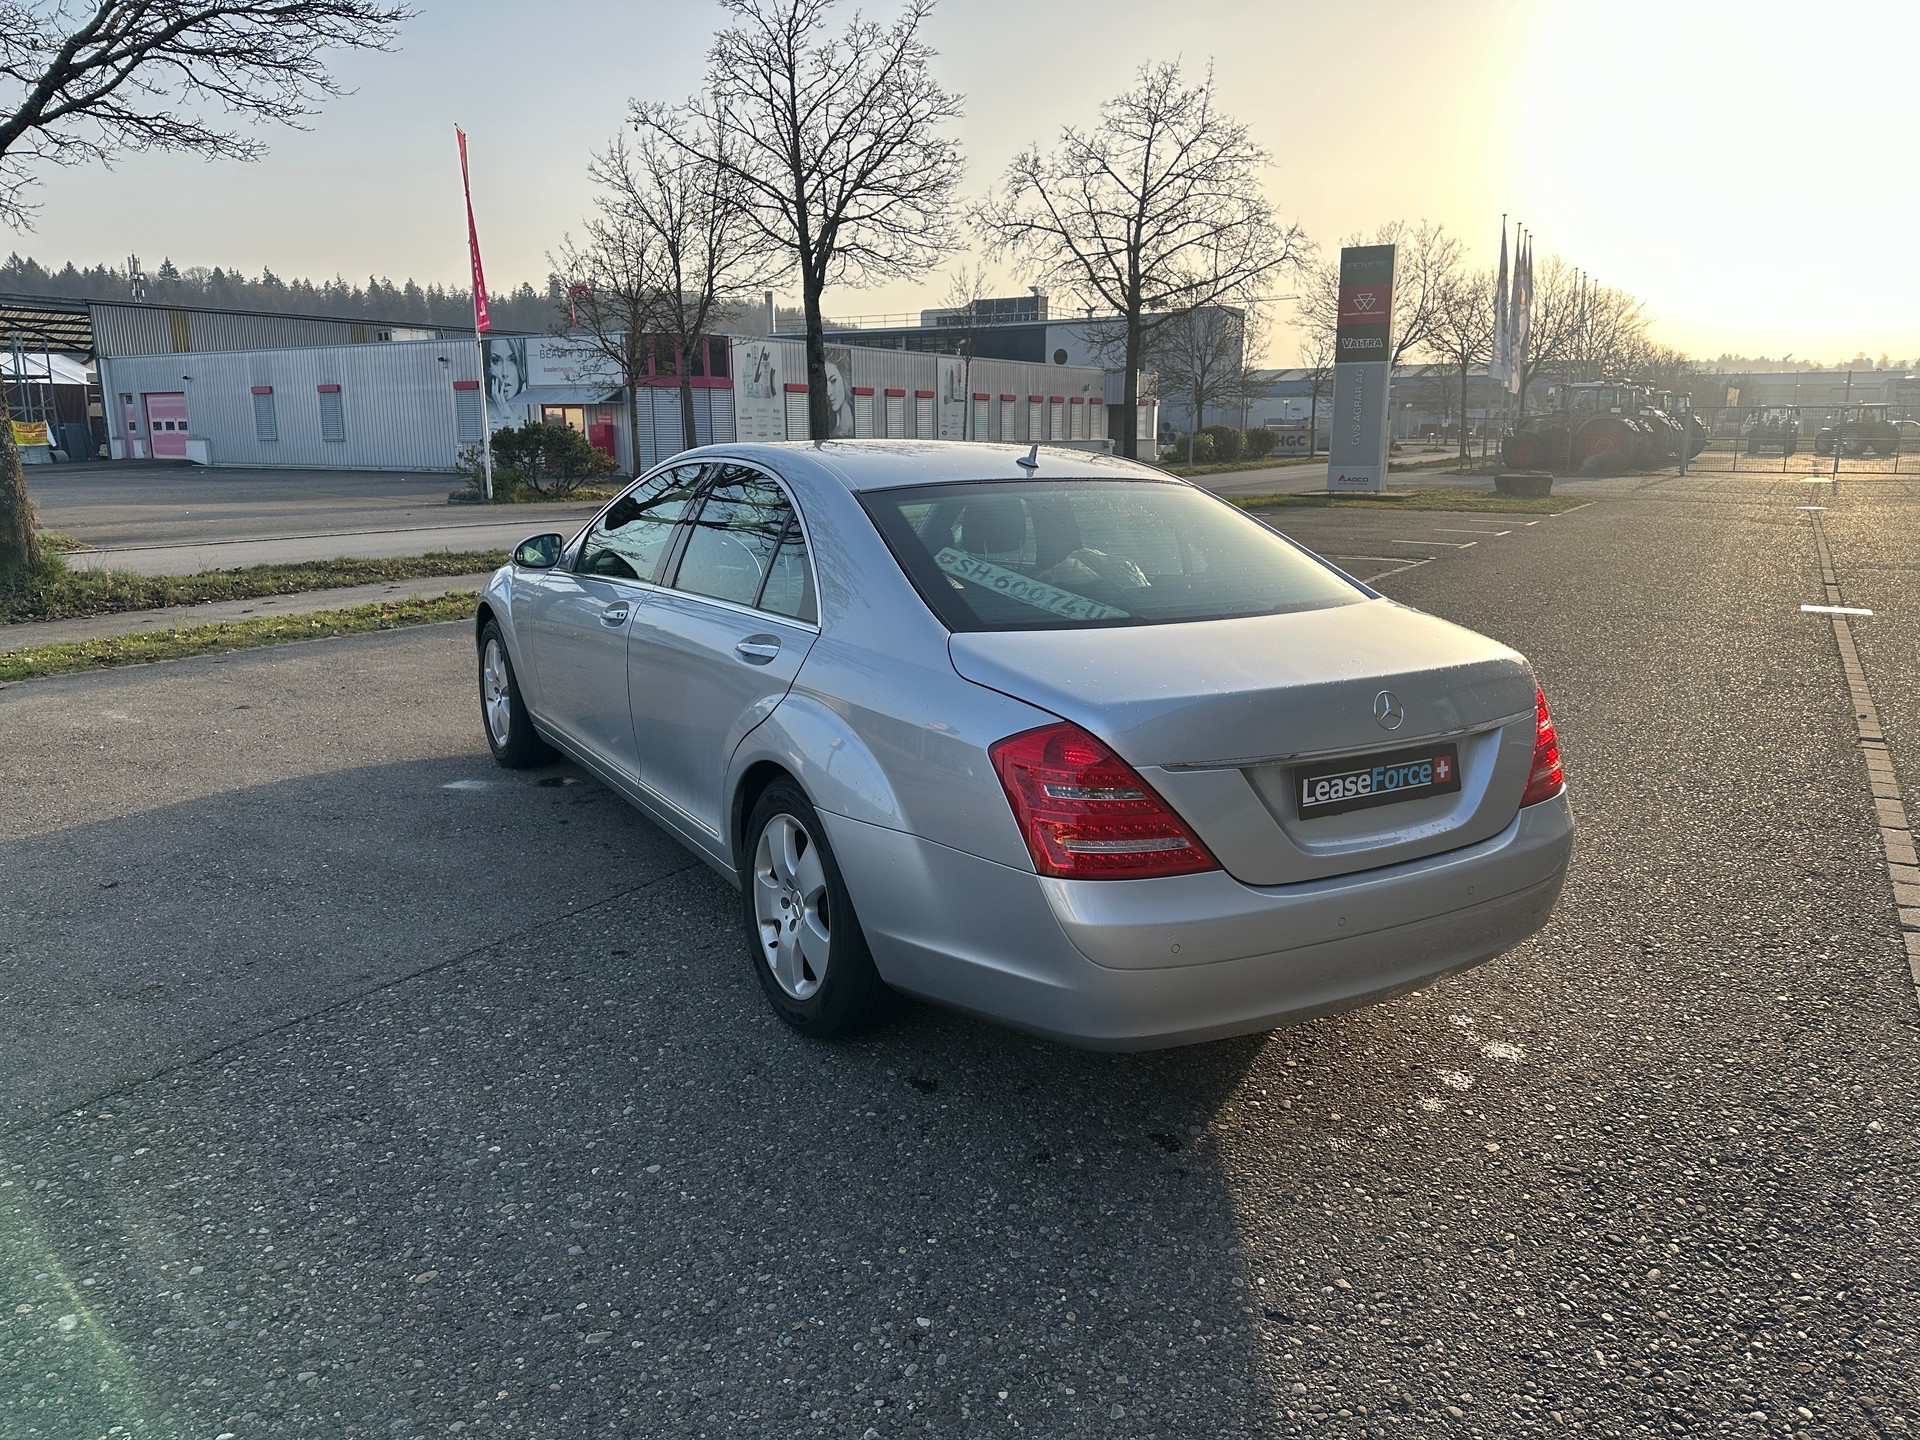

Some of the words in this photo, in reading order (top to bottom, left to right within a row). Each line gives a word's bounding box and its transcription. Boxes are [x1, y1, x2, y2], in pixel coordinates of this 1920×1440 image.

[1341, 337, 1383, 349] VALTRA
[1355, 368, 1365, 384] AG
[1353, 387, 1363, 422] AGRAR
[1351, 424, 1361, 446] GVS
[1302, 763, 1432, 804] LeaseForce
